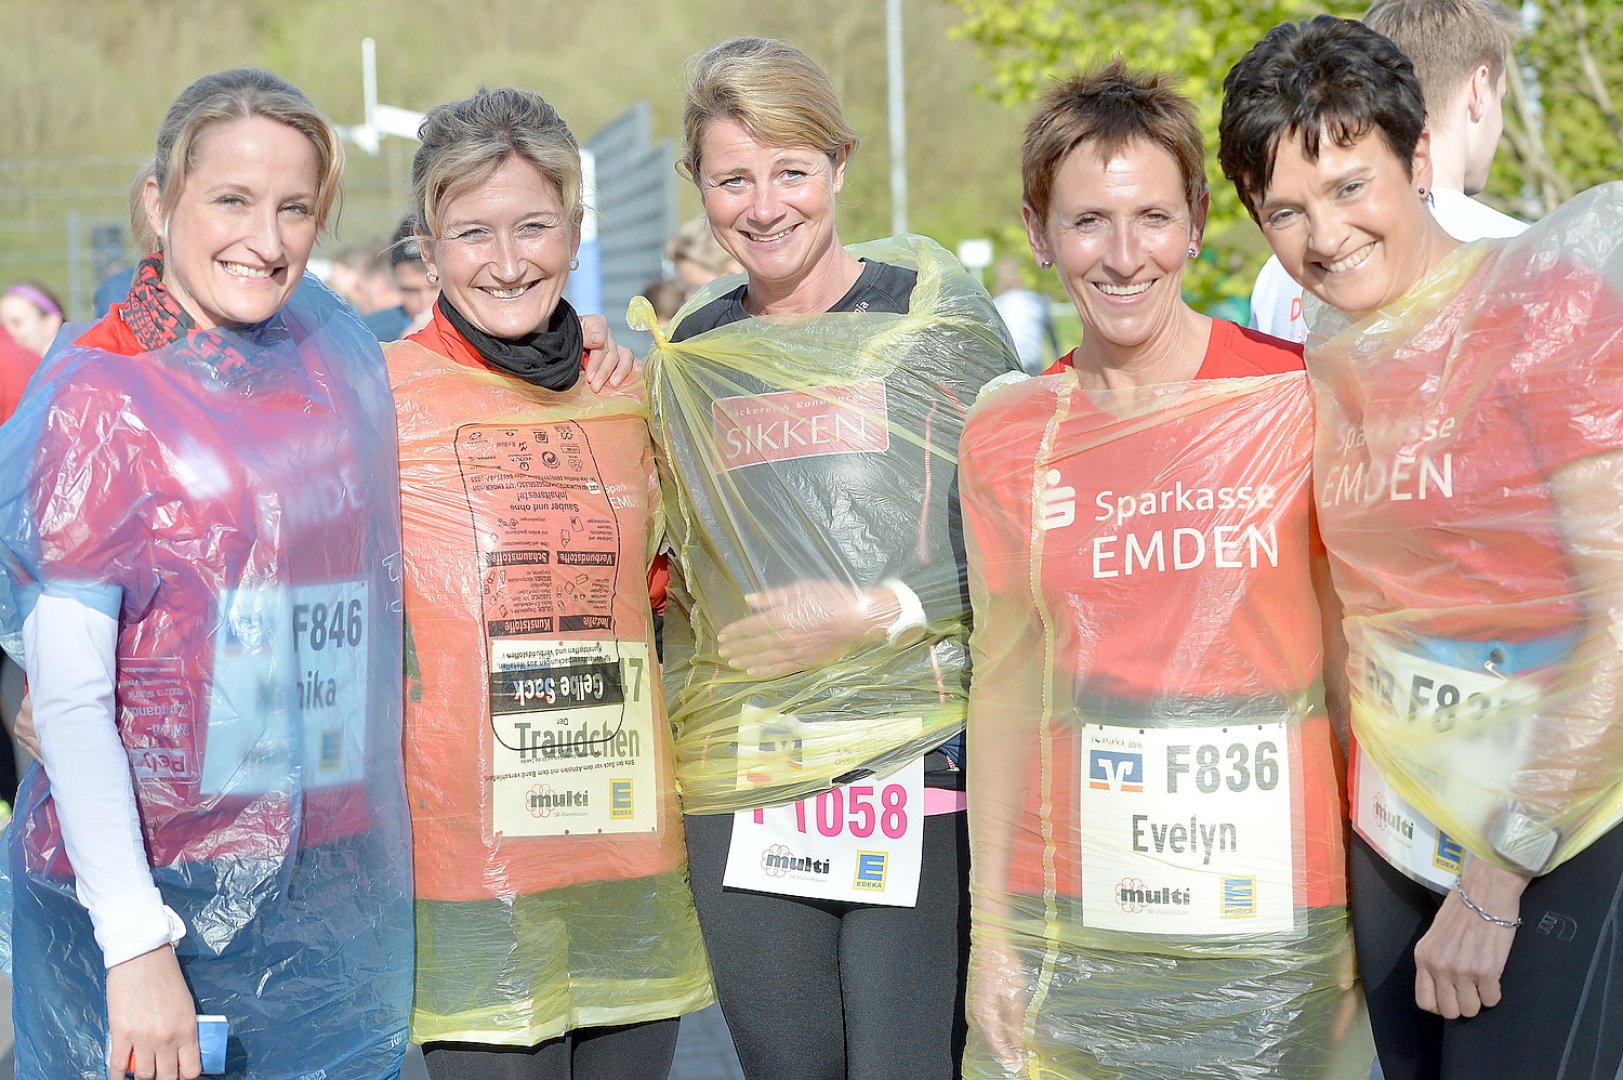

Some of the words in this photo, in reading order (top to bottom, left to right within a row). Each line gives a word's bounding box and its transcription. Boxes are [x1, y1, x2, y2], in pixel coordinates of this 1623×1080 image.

[726, 413, 867, 460] SIKKEN
[1320, 453, 1453, 509] EMDEN
[534, 503, 550, 512] und
[551, 503, 580, 512] Sauber
[1094, 480, 1276, 526] Sparkasse
[490, 552, 548, 564] Schaumstoffe
[559, 552, 612, 563] Verbundstoffe
[1093, 524, 1279, 579] EMDEN
[504, 618, 551, 633] Kunststoffe
[513, 677, 556, 706] Sack
[560, 672, 604, 701] Gelbe
[514, 720, 640, 759] Traudchen
[1167, 741, 1280, 794] F836
[530, 790, 589, 808] multi
[1375, 802, 1414, 840] multi
[1132, 814, 1237, 865] Evelyn
[766, 853, 830, 874] multi
[1120, 887, 1190, 906] multi
